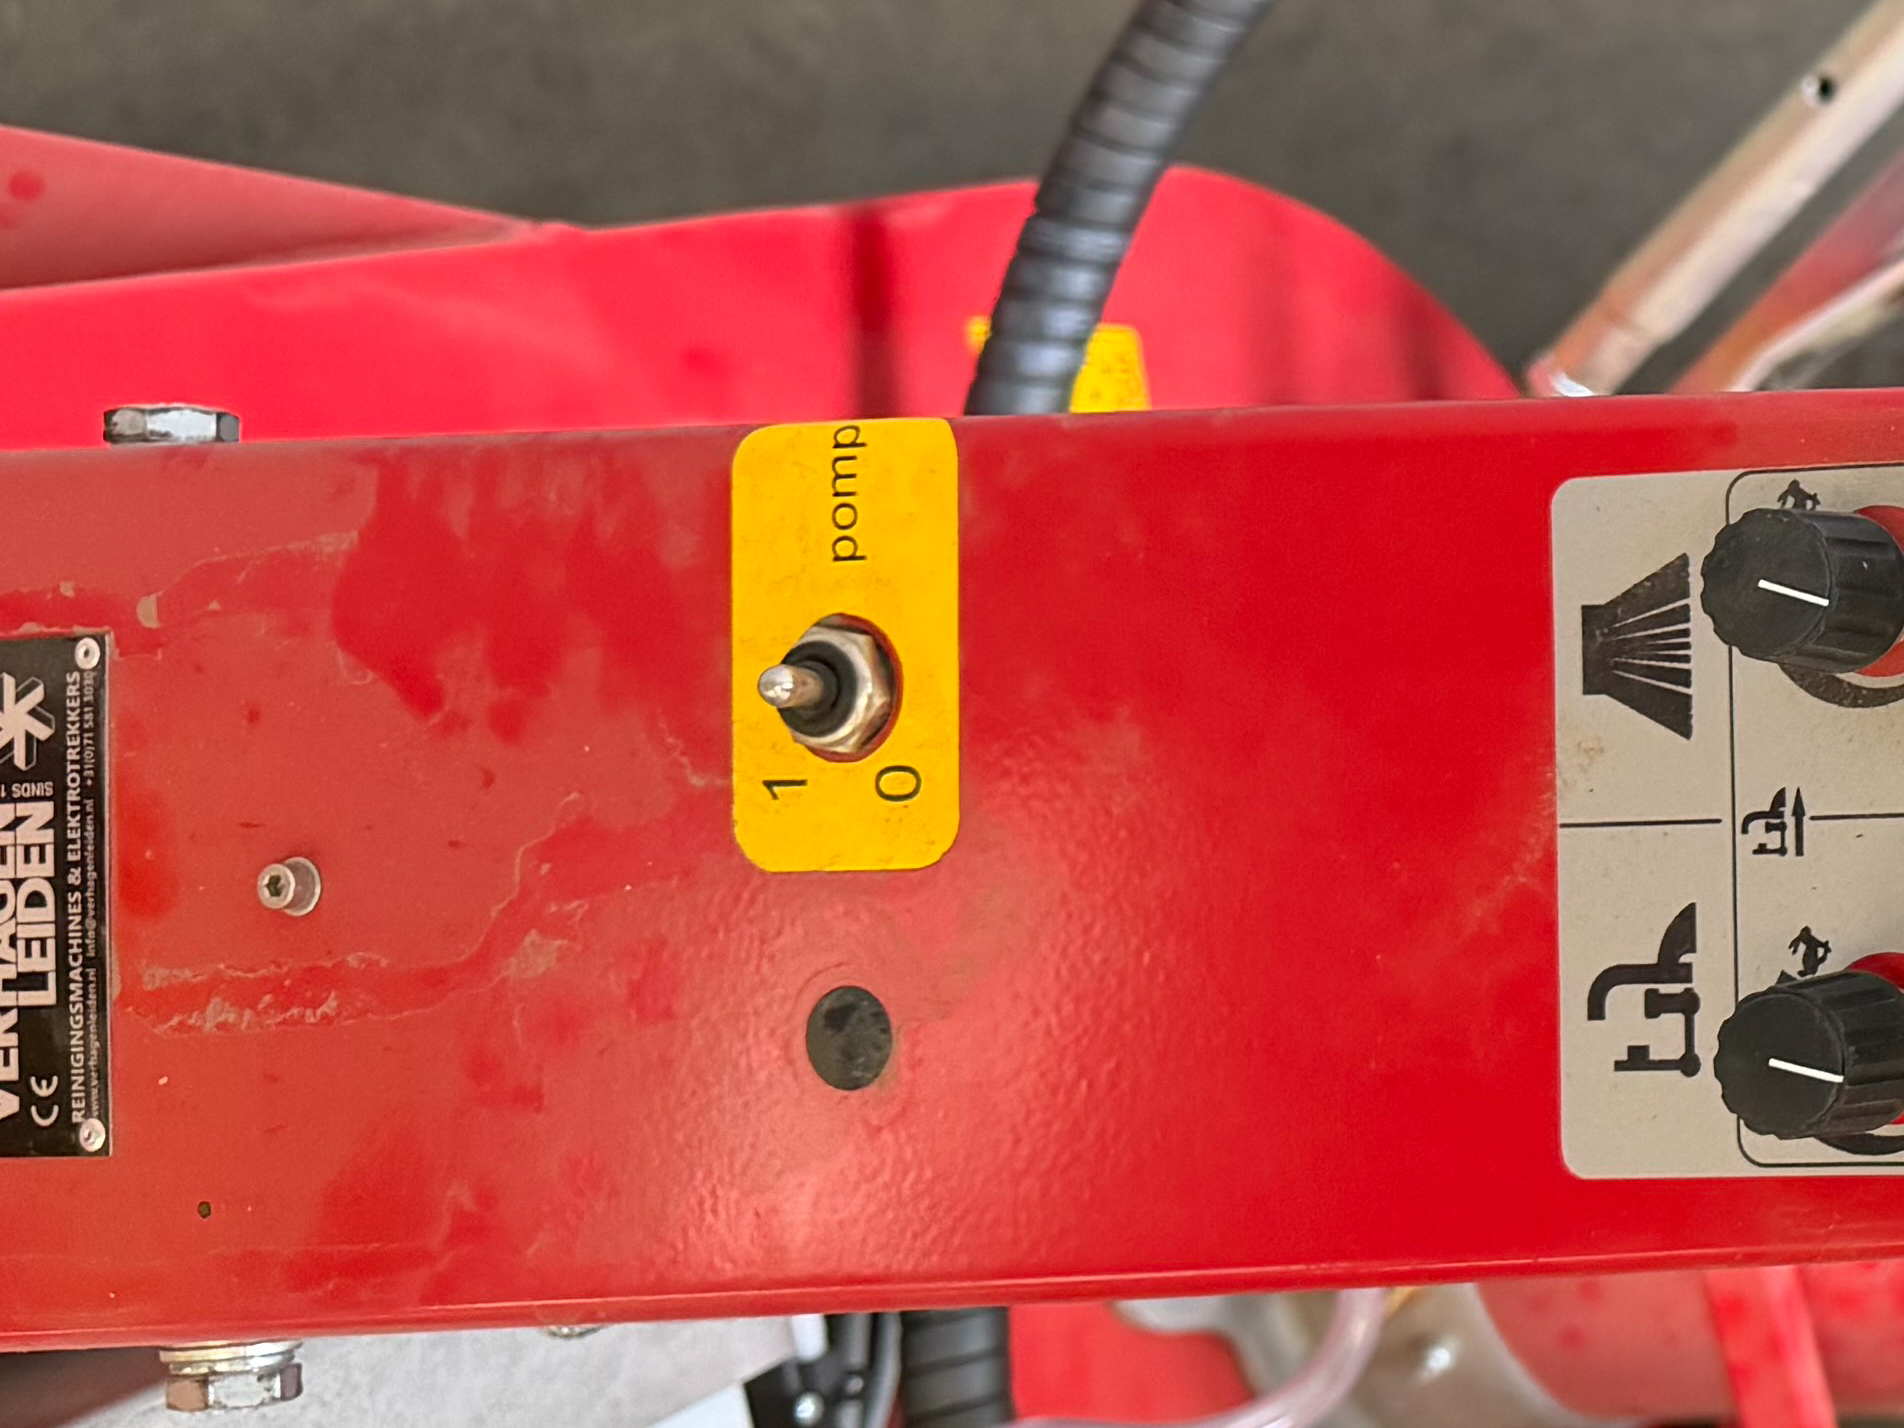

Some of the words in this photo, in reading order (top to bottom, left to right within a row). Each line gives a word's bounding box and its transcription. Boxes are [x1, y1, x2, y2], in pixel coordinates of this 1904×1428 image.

[830, 424, 867, 563] pomp
[11, 780, 54, 798] SINDS
[66, 670, 82, 862] ELEKTROTREKKERS
[761, 778, 809, 802] 1
[874, 764, 923, 803] 0
[16, 800, 57, 1007] LEIDEN
[67, 870, 82, 887] &
[68, 889, 86, 1125] REINIGINGSMACHINES
[30, 1075, 60, 1127] CE
